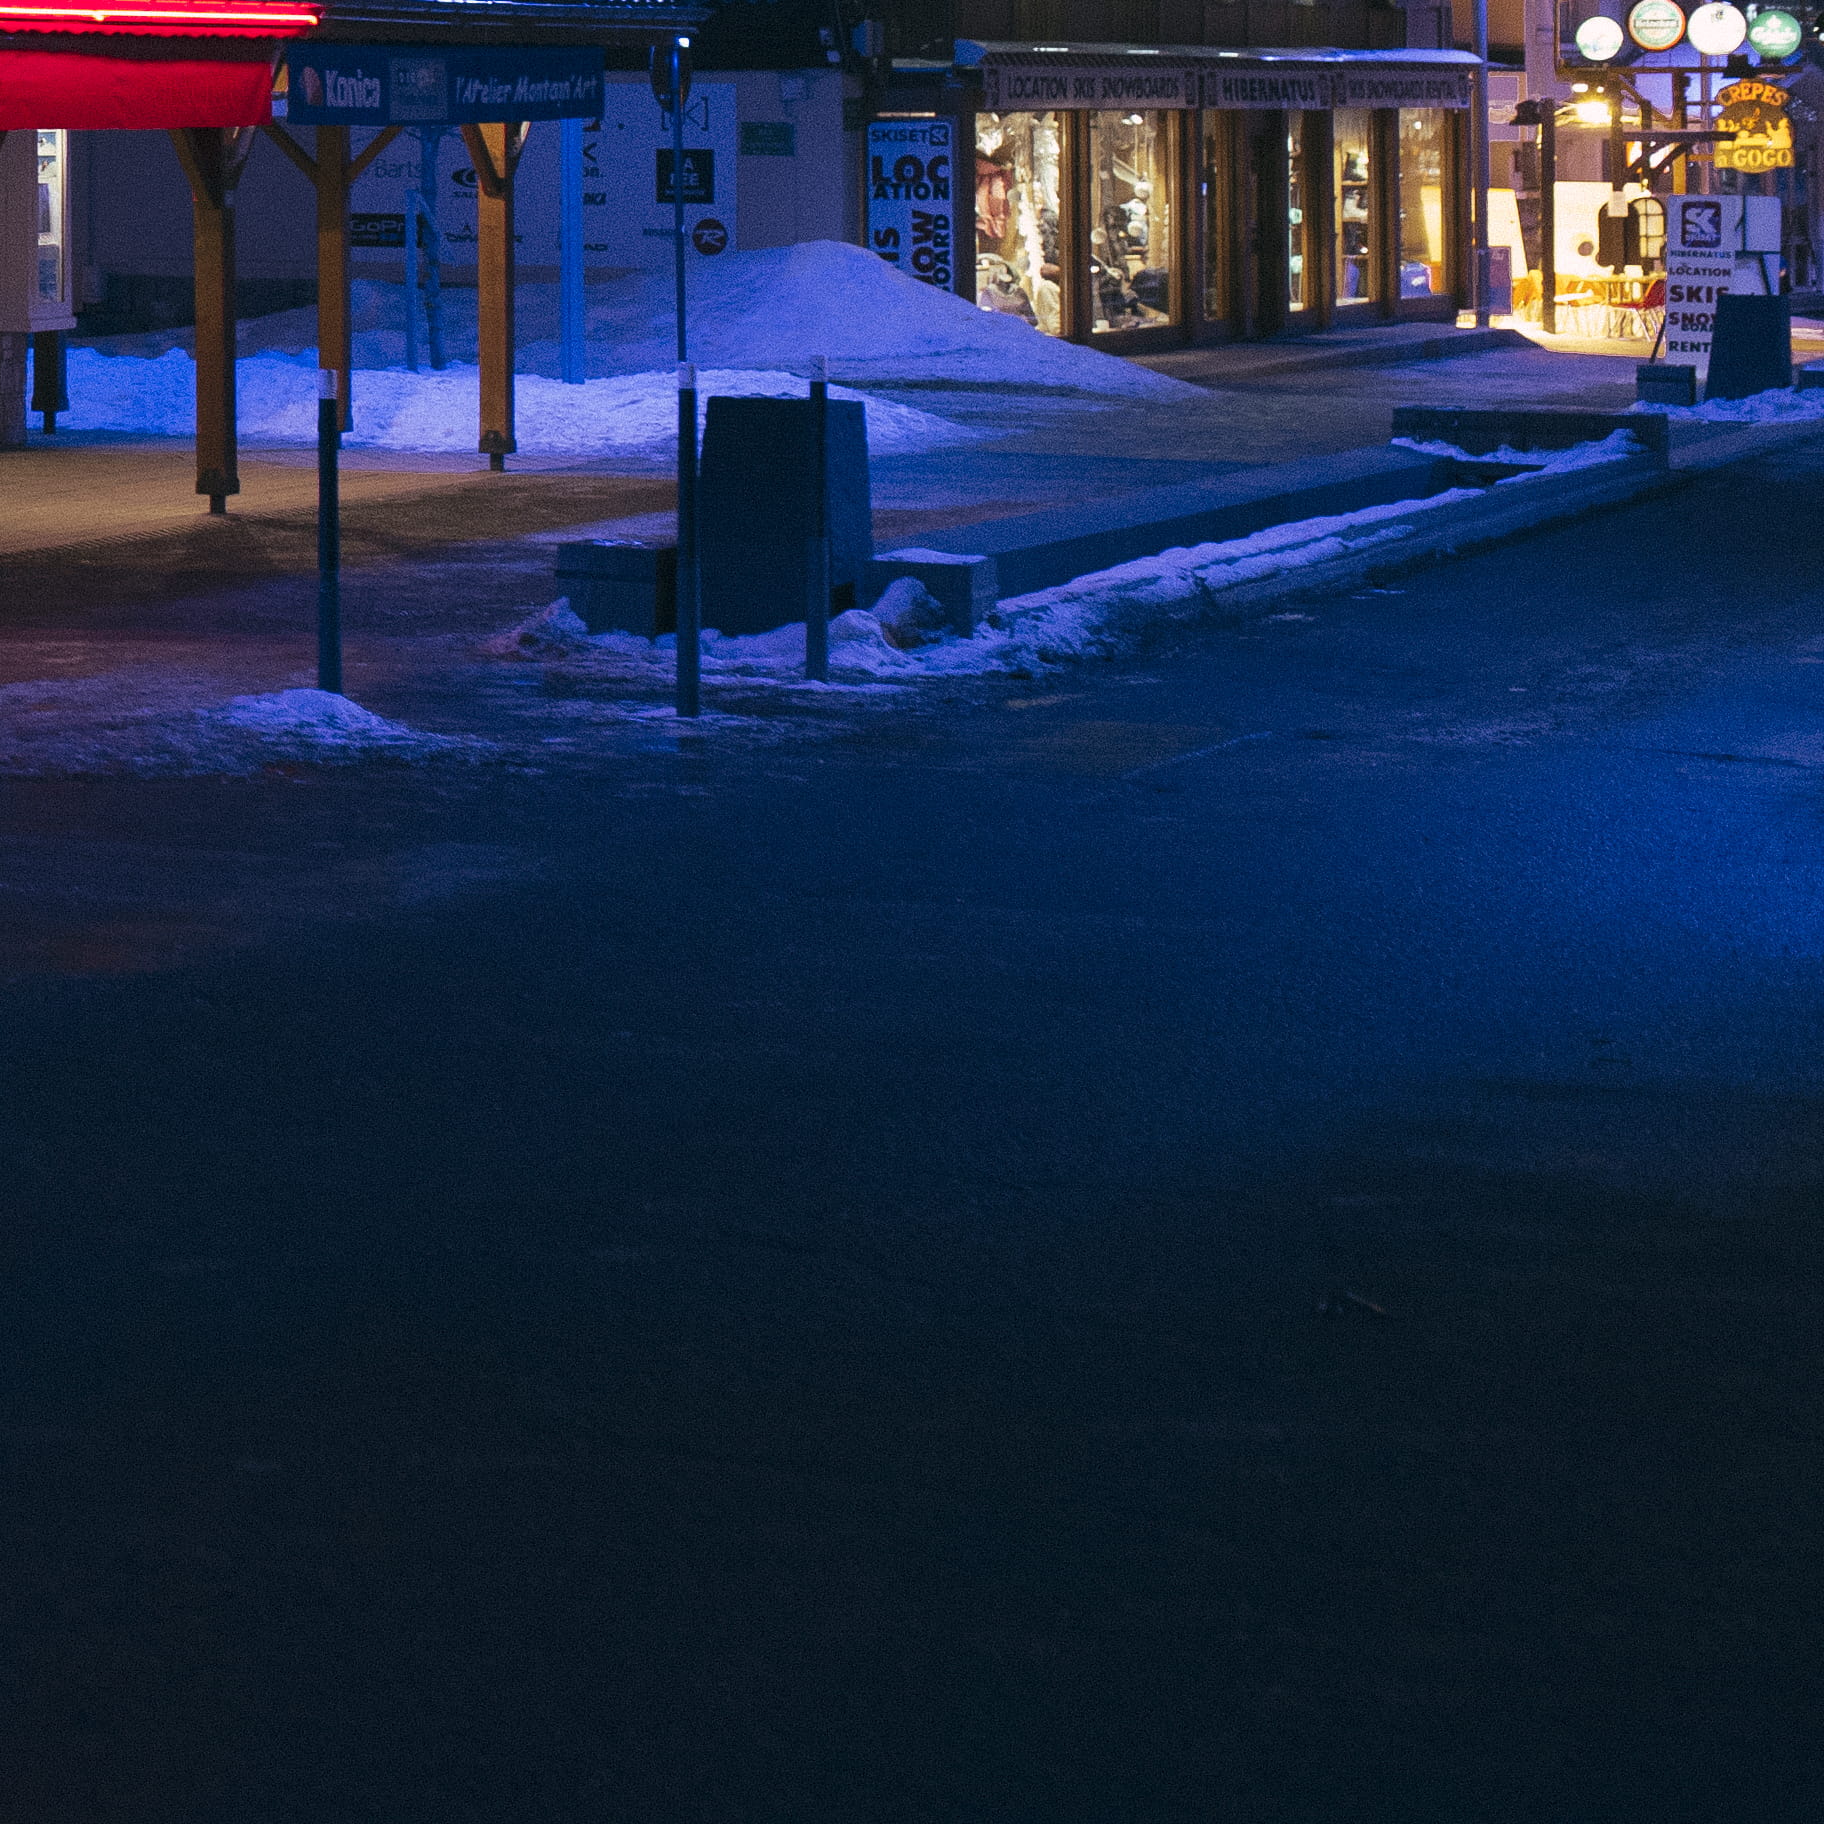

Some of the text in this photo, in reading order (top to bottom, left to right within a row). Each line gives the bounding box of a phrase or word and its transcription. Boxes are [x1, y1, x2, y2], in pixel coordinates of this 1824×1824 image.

[324, 68, 382, 109] Konica
[1007, 76, 1068, 99] LOCATION
[1102, 76, 1179, 99] SNOWBOARDS
[1222, 78, 1316, 102] HIBERNATUS
[871, 128, 930, 143] SKISET
[1732, 149, 1792, 167] GOGO
[872, 154, 948, 186] LOC
[873, 183, 949, 201] ATION
[350, 219, 405, 233] GoPr
[933, 213, 951, 290] OARD
[1670, 249, 1732, 259] HIBERNATUS
[1668, 266, 1732, 277] LOCATION
[1668, 312, 1717, 326] SNO
